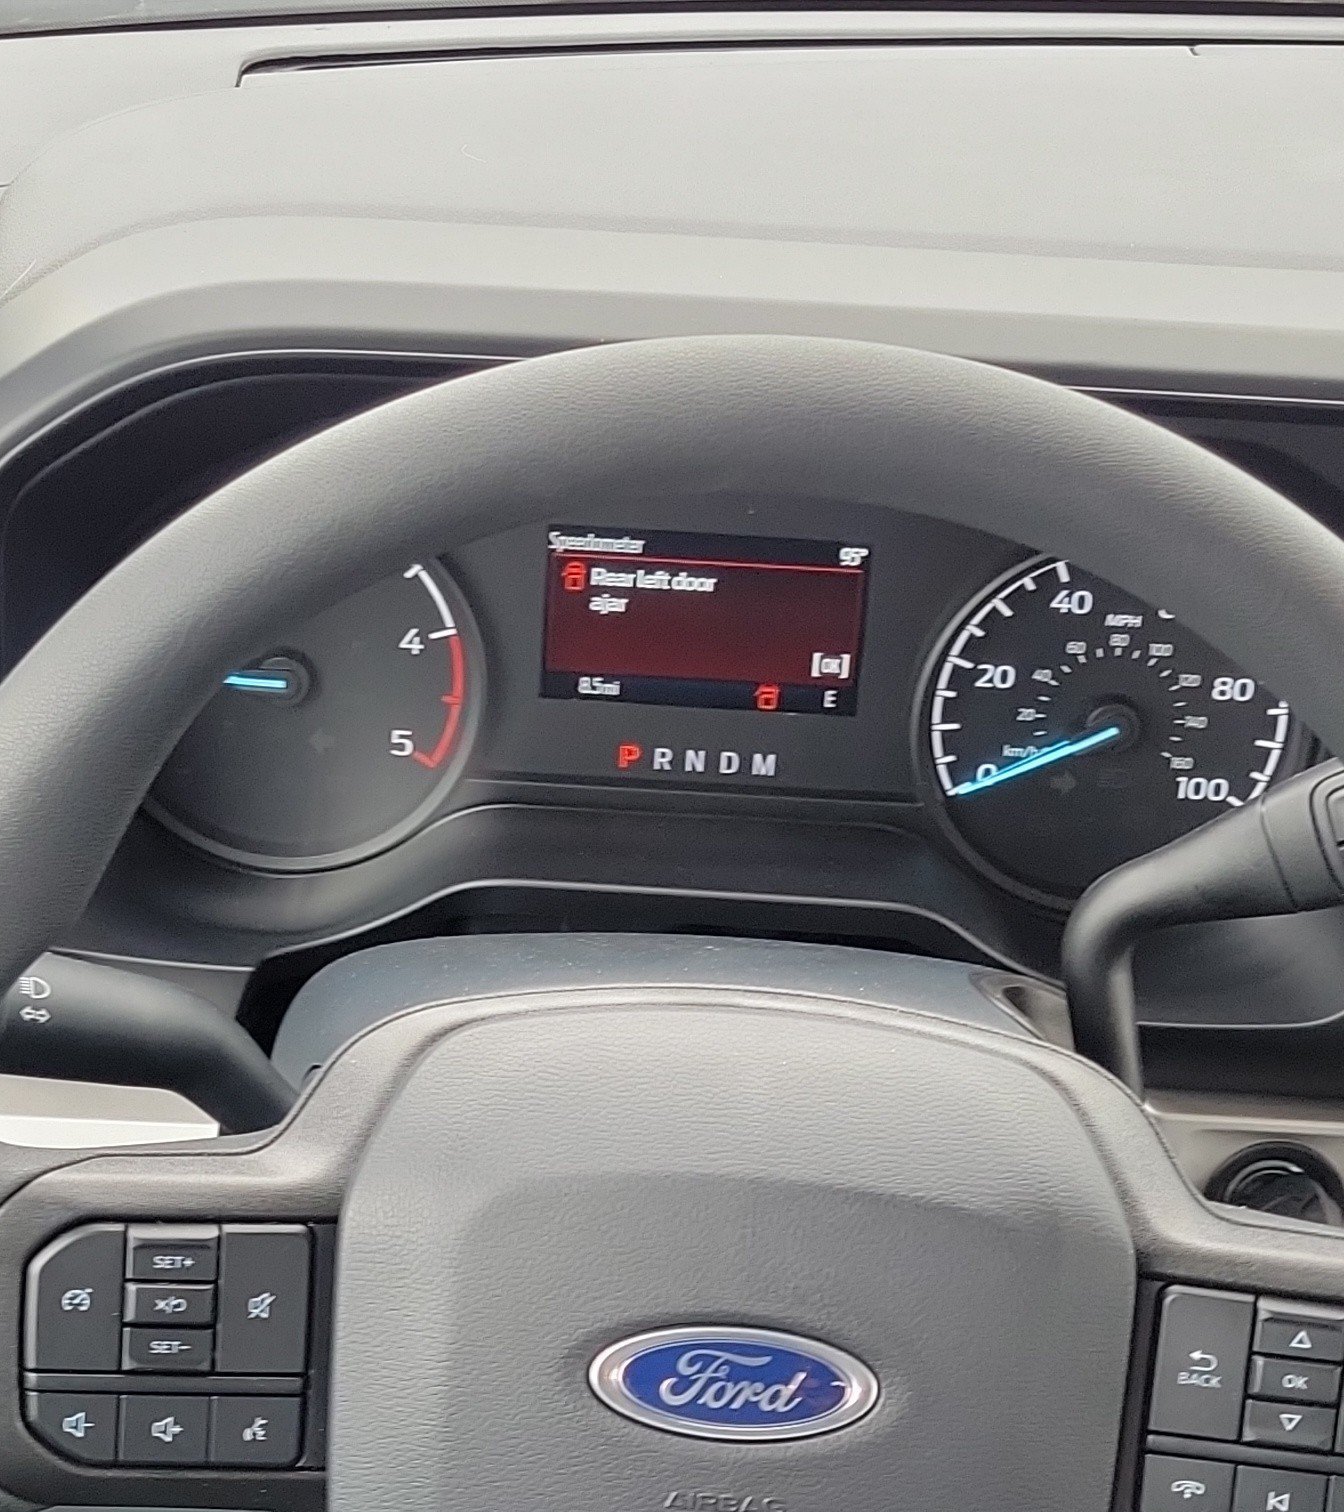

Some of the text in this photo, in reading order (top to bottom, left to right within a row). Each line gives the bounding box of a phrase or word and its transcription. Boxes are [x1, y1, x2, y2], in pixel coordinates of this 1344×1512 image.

[590, 567, 718, 592] Rear left door
[589, 594, 630, 614] ajar
[1050, 589, 1093, 615] 40
[1105, 613, 1143, 628] MPH
[398, 628, 425, 655] 4
[974, 664, 1016, 689] 20
[823, 690, 838, 708] E
[1211, 677, 1255, 702] 80
[390, 729, 414, 756] 5
[618, 745, 777, 777] P R N D M
[1175, 776, 1229, 801] 100
[658, 1349, 807, 1413] Ford
[1176, 1371, 1222, 1389] BACK
[1281, 1374, 1309, 1390] OK
